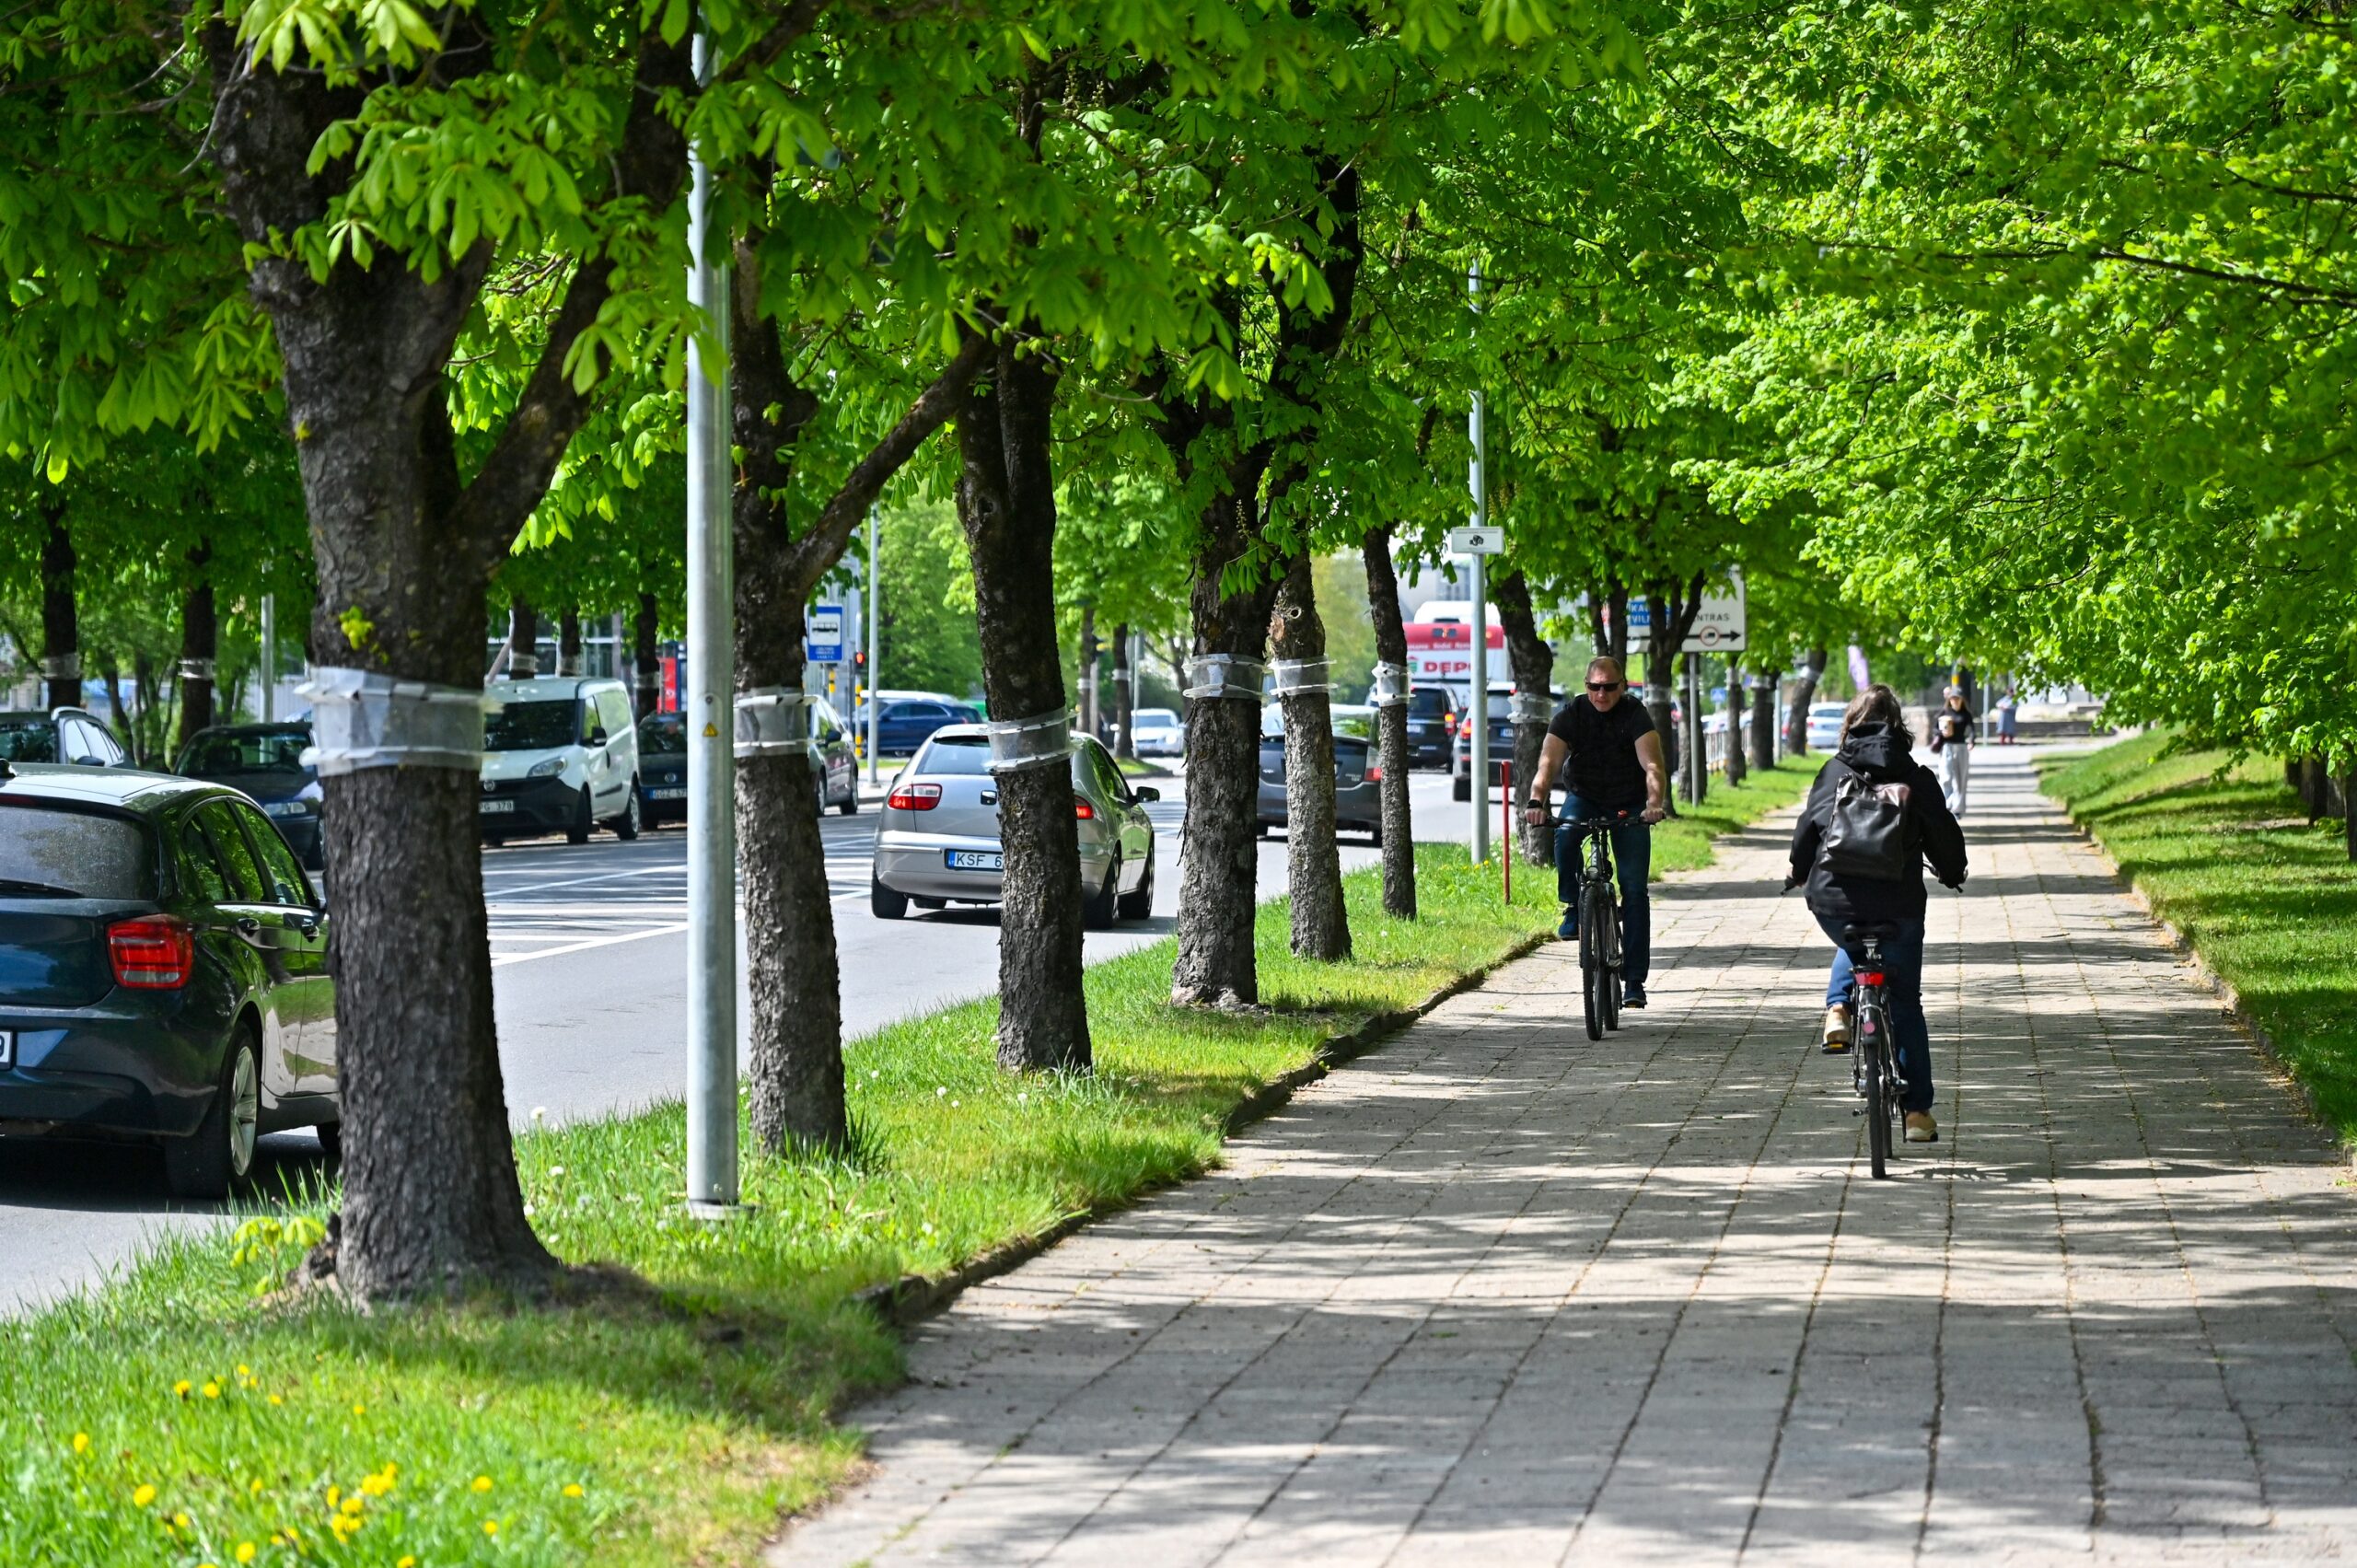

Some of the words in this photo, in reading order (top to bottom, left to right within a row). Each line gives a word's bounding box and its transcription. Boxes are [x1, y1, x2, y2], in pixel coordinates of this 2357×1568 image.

[1696, 613, 1730, 621] NTRAS
[1424, 662, 1471, 673] DEP
[957, 854, 986, 866] KSF
[994, 855, 1003, 867] 6
